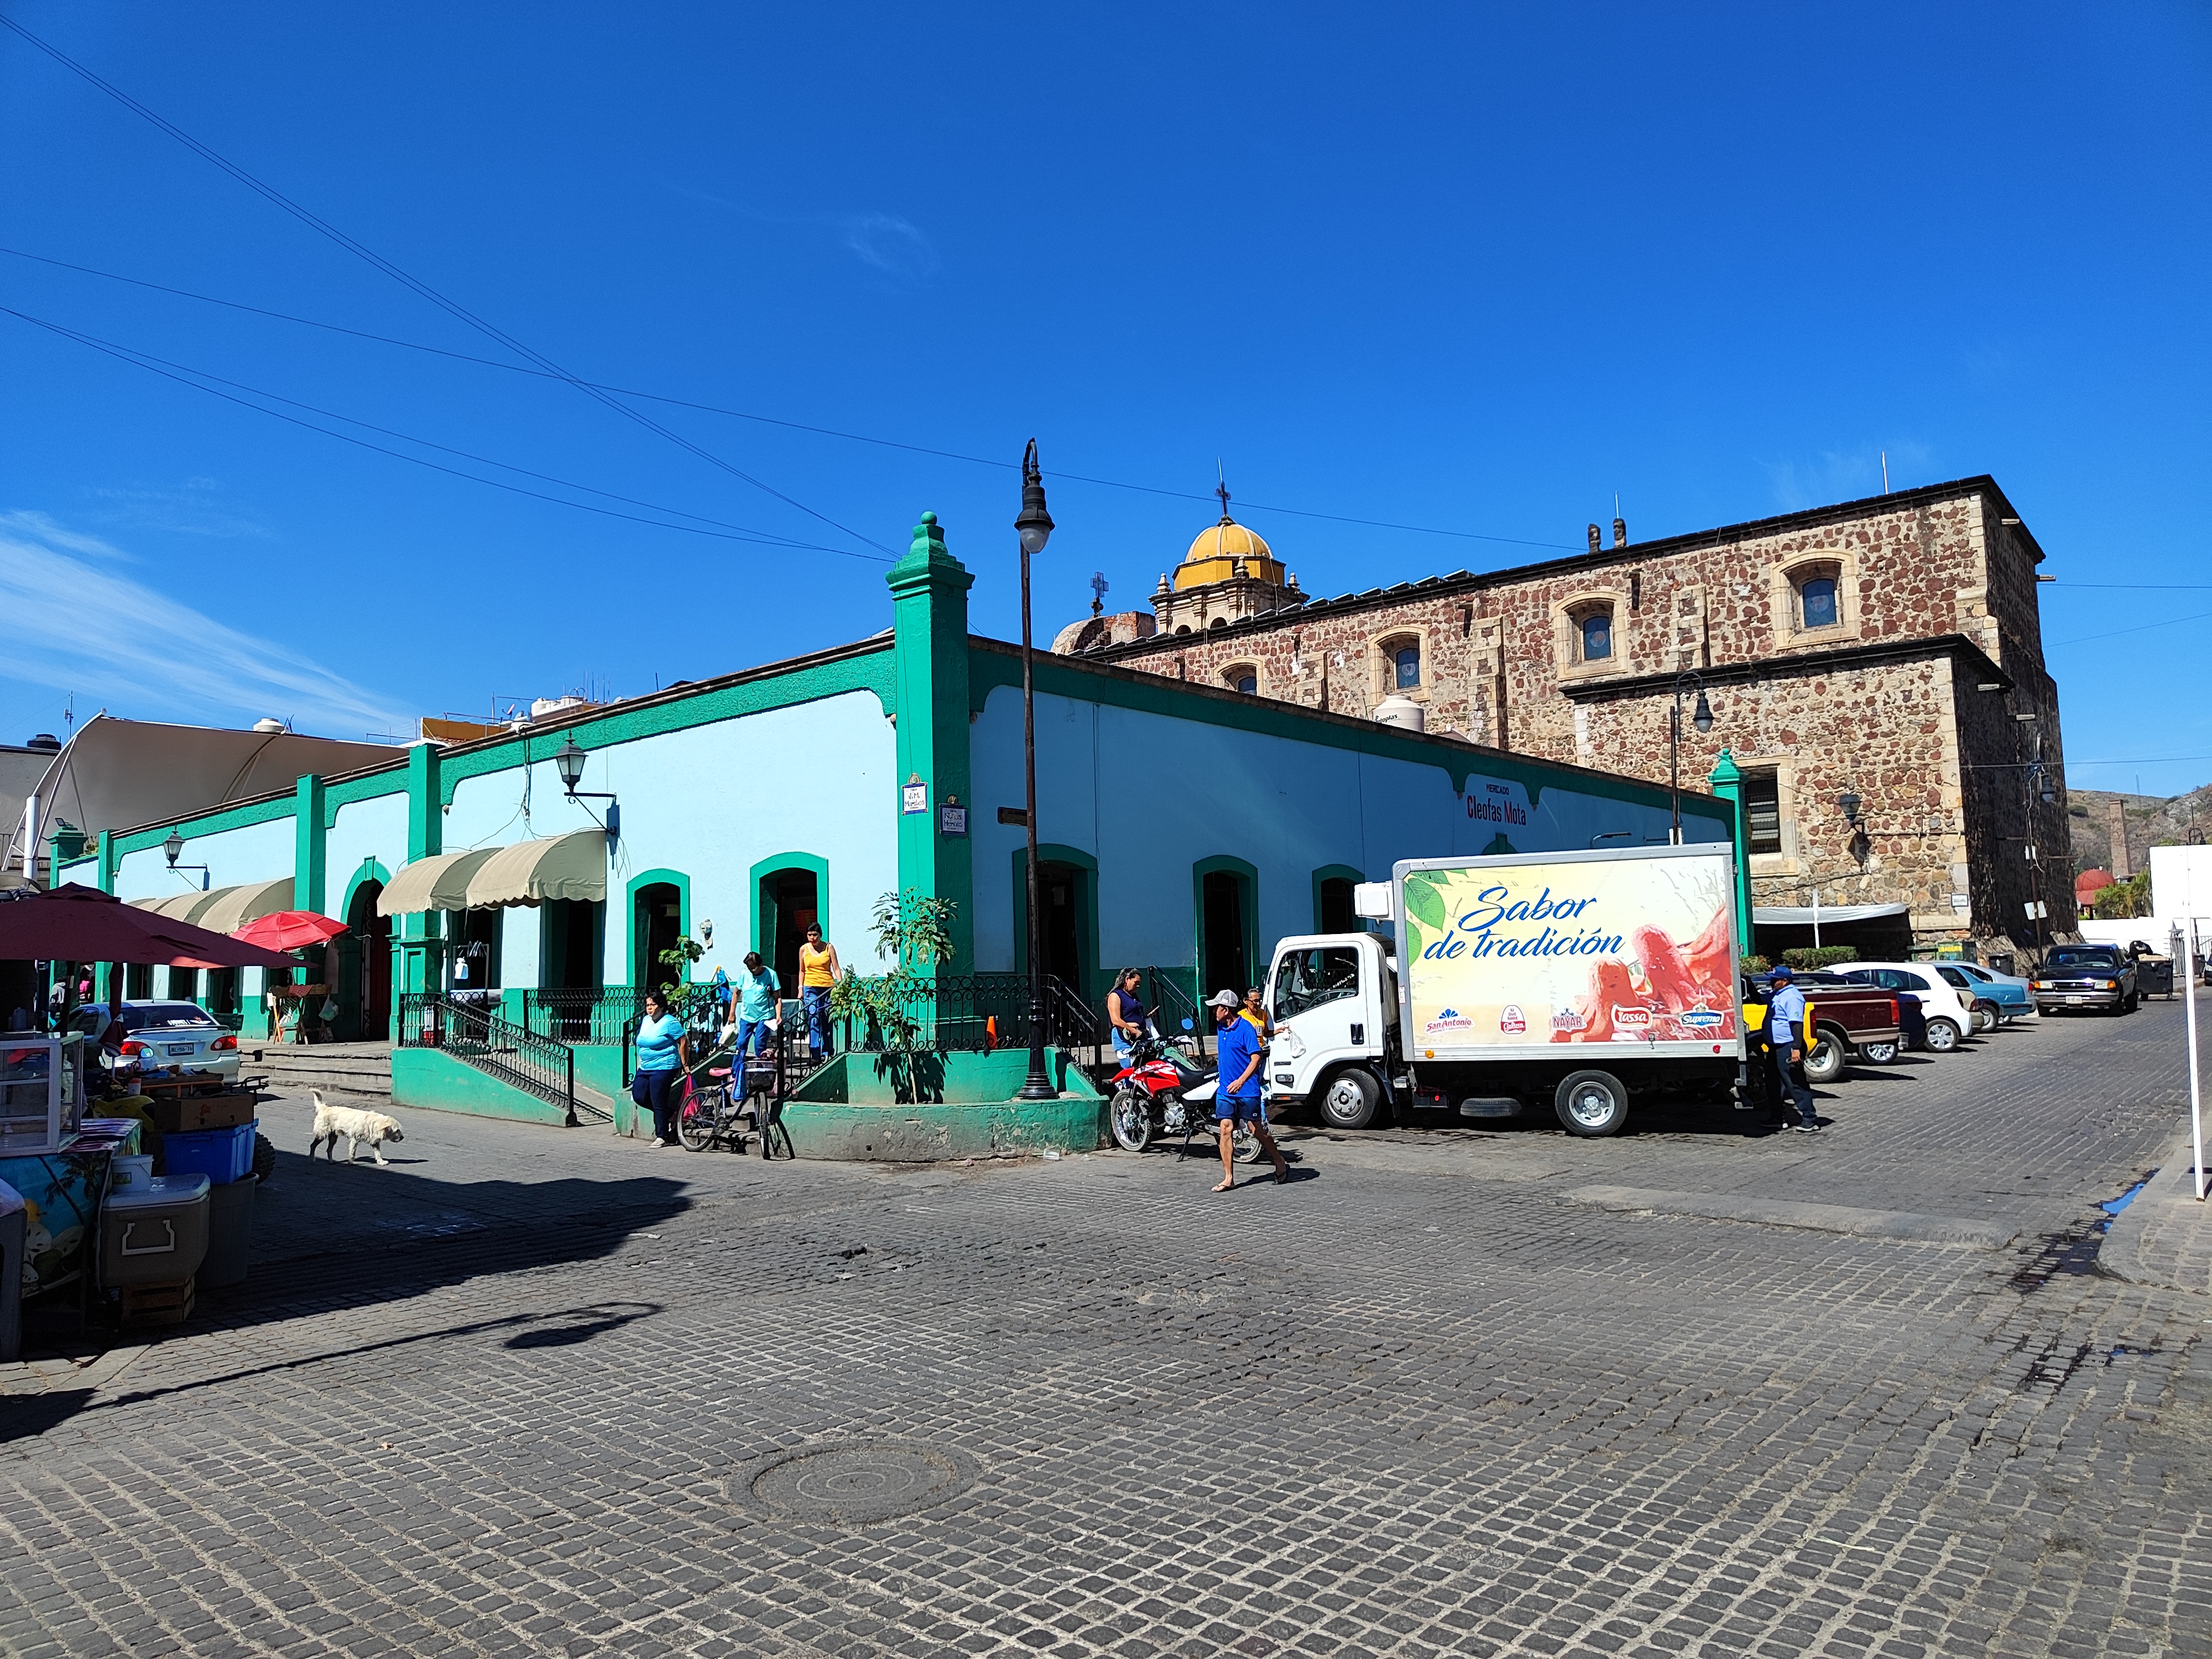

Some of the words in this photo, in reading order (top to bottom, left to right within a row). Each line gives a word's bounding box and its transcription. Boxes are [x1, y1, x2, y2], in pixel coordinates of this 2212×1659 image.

[1486, 783, 1510, 796] MERCADO
[1467, 795, 1502, 823] Cleofas
[1504, 800, 1527, 826] Mota
[1458, 886, 1597, 932] Sabor
[1424, 930, 1468, 959] de
[1473, 926, 1626, 958] tradición
[1442, 1018, 1472, 1027] Antonio
[1553, 1016, 1583, 1030] NAYAR
[1682, 1014, 1721, 1024] Supremo
